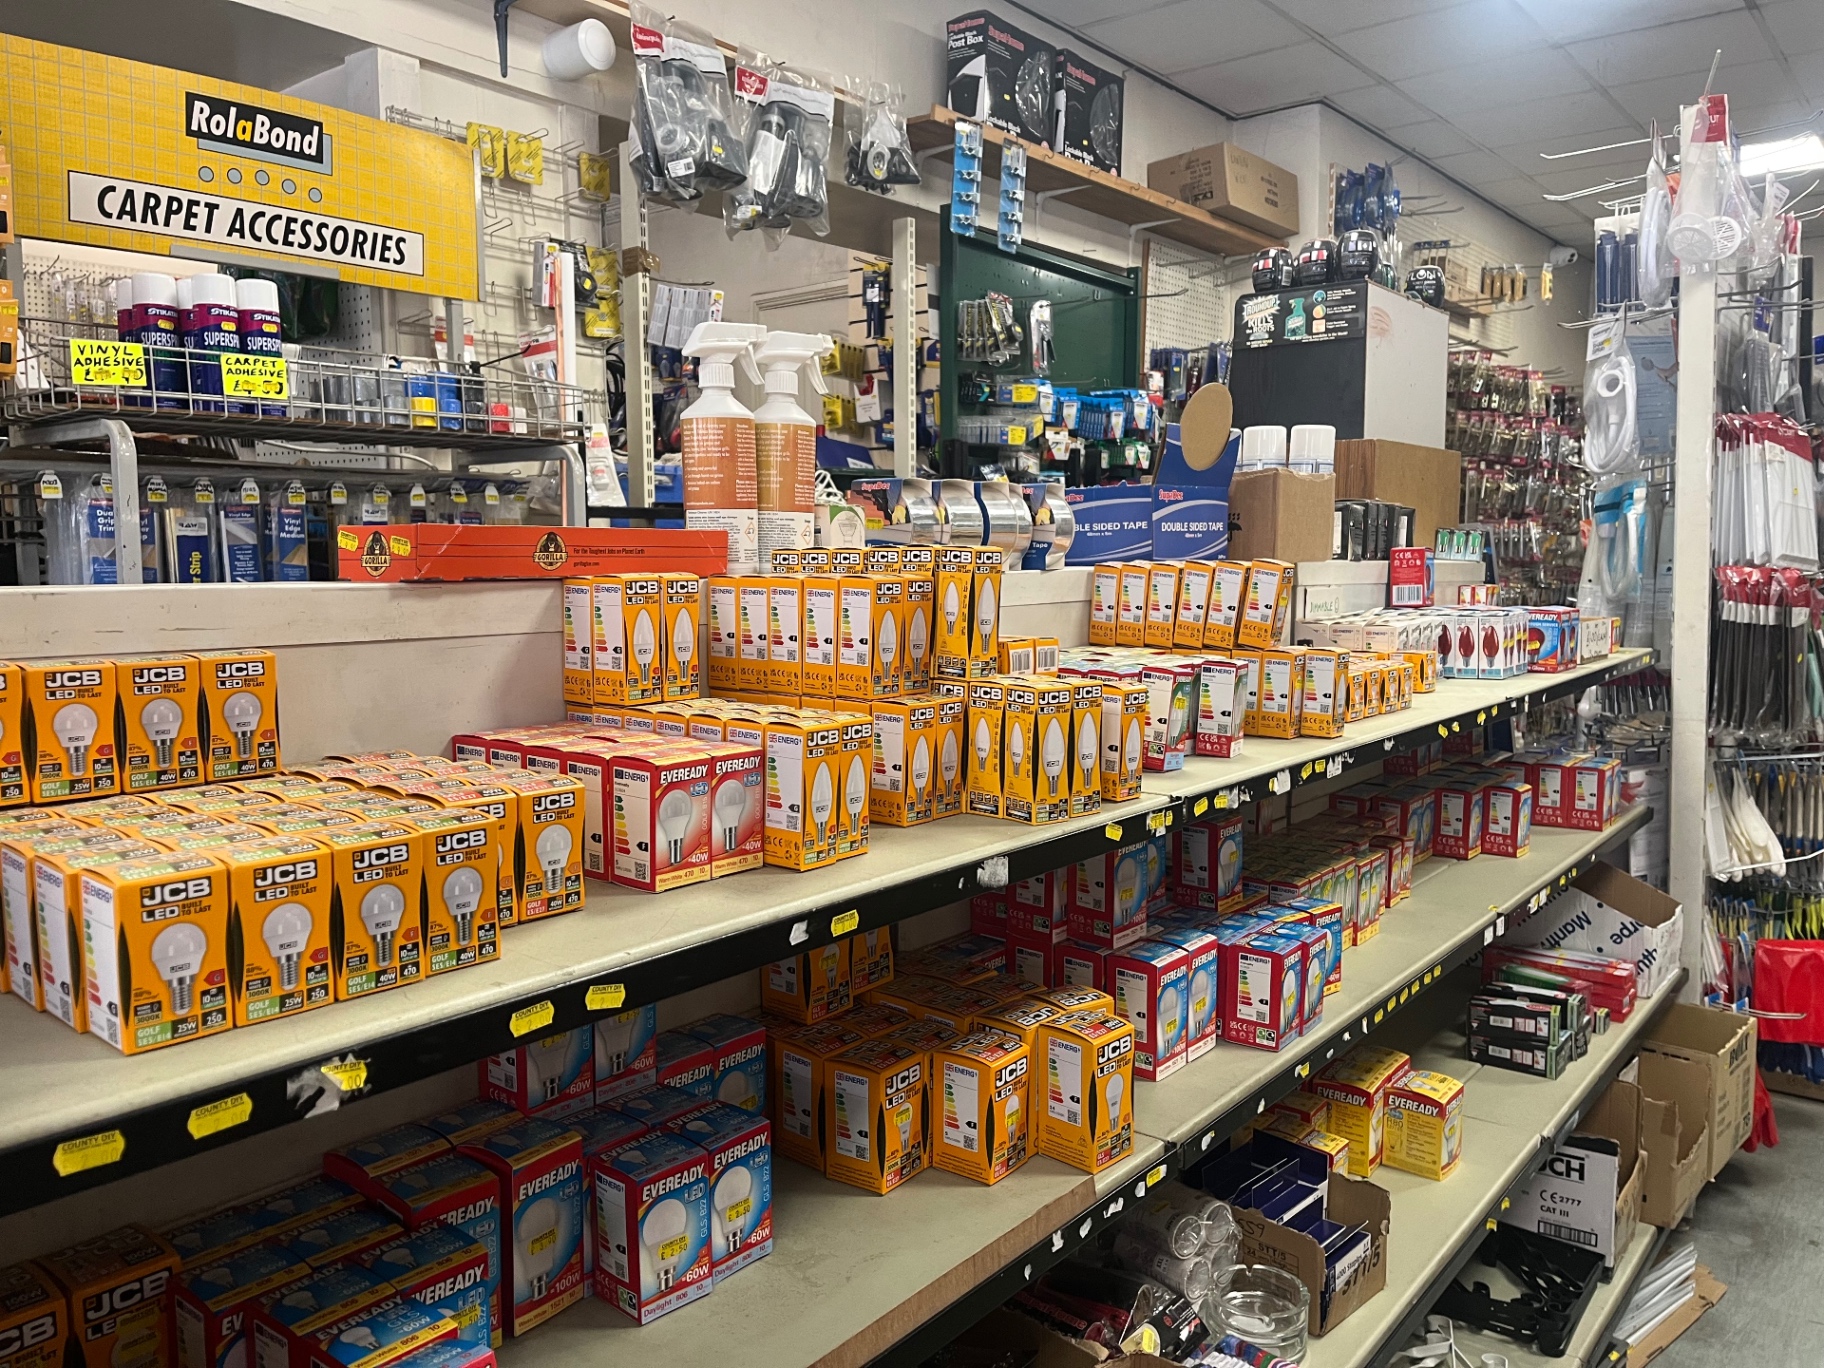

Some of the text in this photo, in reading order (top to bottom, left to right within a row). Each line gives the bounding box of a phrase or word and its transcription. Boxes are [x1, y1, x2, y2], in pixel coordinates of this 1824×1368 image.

[948, 37, 966, 49] Post
[966, 34, 984, 45] Box
[190, 100, 320, 157] RolaBond
[97, 184, 408, 267] CARPET ACCESSORIES
[1246, 299, 1276, 316] ROUNDUP
[1248, 315, 1274, 328] KILLS
[1253, 324, 1275, 333] ROOTS
[77, 344, 134, 356] VINYL
[74, 357, 144, 367] ADHESIVE
[225, 357, 278, 368] CARPET
[226, 367, 285, 379] ADHESIVE
[861, 482, 890, 491] SupaDec
[1159, 489, 1184, 503] SupaDec
[284, 518, 302, 526] Vinyl
[284, 525, 302, 533] Edge
[1075, 520, 1149, 532] BLE SIDED TAPE
[1161, 522, 1224, 532] DOUBLE SIDED TAPE
[190, 551, 202, 575] Strip
[364, 556, 388, 565] GORILLA
[537, 553, 565, 561] GORILLA
[626, 581, 659, 594] JCB
[667, 581, 698, 594] JCB
[134, 667, 186, 683] JCB
[216, 661, 265, 678] JCB
[46, 671, 102, 688] JCB
[216, 679, 242, 690] LED
[46, 690, 75, 700] LED
[134, 685, 162, 695] LED
[807, 729, 840, 747] JCB
[842, 724, 872, 740] JCB
[842, 741, 859, 751] LED
[213, 763, 231, 772] GOLF
[240, 763, 257, 772] 40W
[715, 757, 761, 775] EVEREADY
[131, 773, 150, 782] GOLF
[660, 764, 709, 785] EVEREADY
[74, 783, 90, 791] 25W
[98, 780, 112, 788] 250
[4, 788, 20, 797] 250
[534, 794, 575, 811] JCB
[479, 805, 506, 819] CB
[533, 811, 557, 824] LED
[436, 831, 487, 853] JCB
[353, 846, 409, 869] JCB
[436, 852, 464, 865] LED
[738, 857, 749, 865] 470
[255, 861, 317, 887] JCB
[353, 868, 383, 883] LED
[684, 870, 695, 878] 470
[142, 877, 211, 907] JCB
[255, 886, 287, 902] LED
[526, 901, 543, 911] GOLF
[549, 899, 564, 909] 40W
[565, 895, 580, 904] 470
[142, 906, 180, 923] LED
[459, 950, 477, 961] 40W
[481, 945, 495, 955] 470
[430, 953, 450, 963] GOLF
[1192, 948, 1217, 970] EVEREADY
[348, 976, 368, 988] GOLF
[379, 971, 398, 983] 40W
[310, 988, 326, 1000] 250
[592, 985, 614, 993] COUNTY
[248, 1002, 270, 1013] GOLF
[283, 997, 303, 1009] 25W
[515, 1002, 550, 1019] COUNTY DIY
[205, 1013, 223, 1025] 250
[136, 1027, 161, 1039] GOLF
[176, 1021, 197, 1034] 25W
[1098, 1035, 1132, 1064] JCB
[719, 1043, 764, 1072] EVEREADY
[664, 1063, 712, 1088] EVEREADY
[995, 1058, 1028, 1087] JCB
[1097, 1061, 1116, 1078] LED
[886, 1064, 921, 1095] JCB
[995, 1086, 1013, 1102] LED
[1317, 1086, 1367, 1107] EVEREADY
[195, 1095, 245, 1117] COUNTY DIY
[886, 1093, 905, 1110] LED
[1388, 1094, 1440, 1117] EVEREADY
[62, 1132, 117, 1151] COUNTY DIY
[714, 1132, 768, 1170] EVEREADY
[519, 1159, 580, 1201] EVEREADY
[642, 1164, 705, 1203] EVEREADY
[1559, 1195, 1582, 1207] 2777
[699, 1196, 708, 1238] GLS B22
[1540, 1204, 1570, 1218] CAT III
[1258, 1243, 1287, 1260] STT/5
[714, 1244, 766, 1278] Daylight 806 10
[643, 1283, 704, 1318] Daylight 806 10
[315, 1295, 404, 1342] EVEREADY
[387, 1310, 421, 1329] GLS
[0, 1314, 56, 1358] CB
[86, 1317, 117, 1342] LE
[376, 1323, 442, 1359] White 806 10
